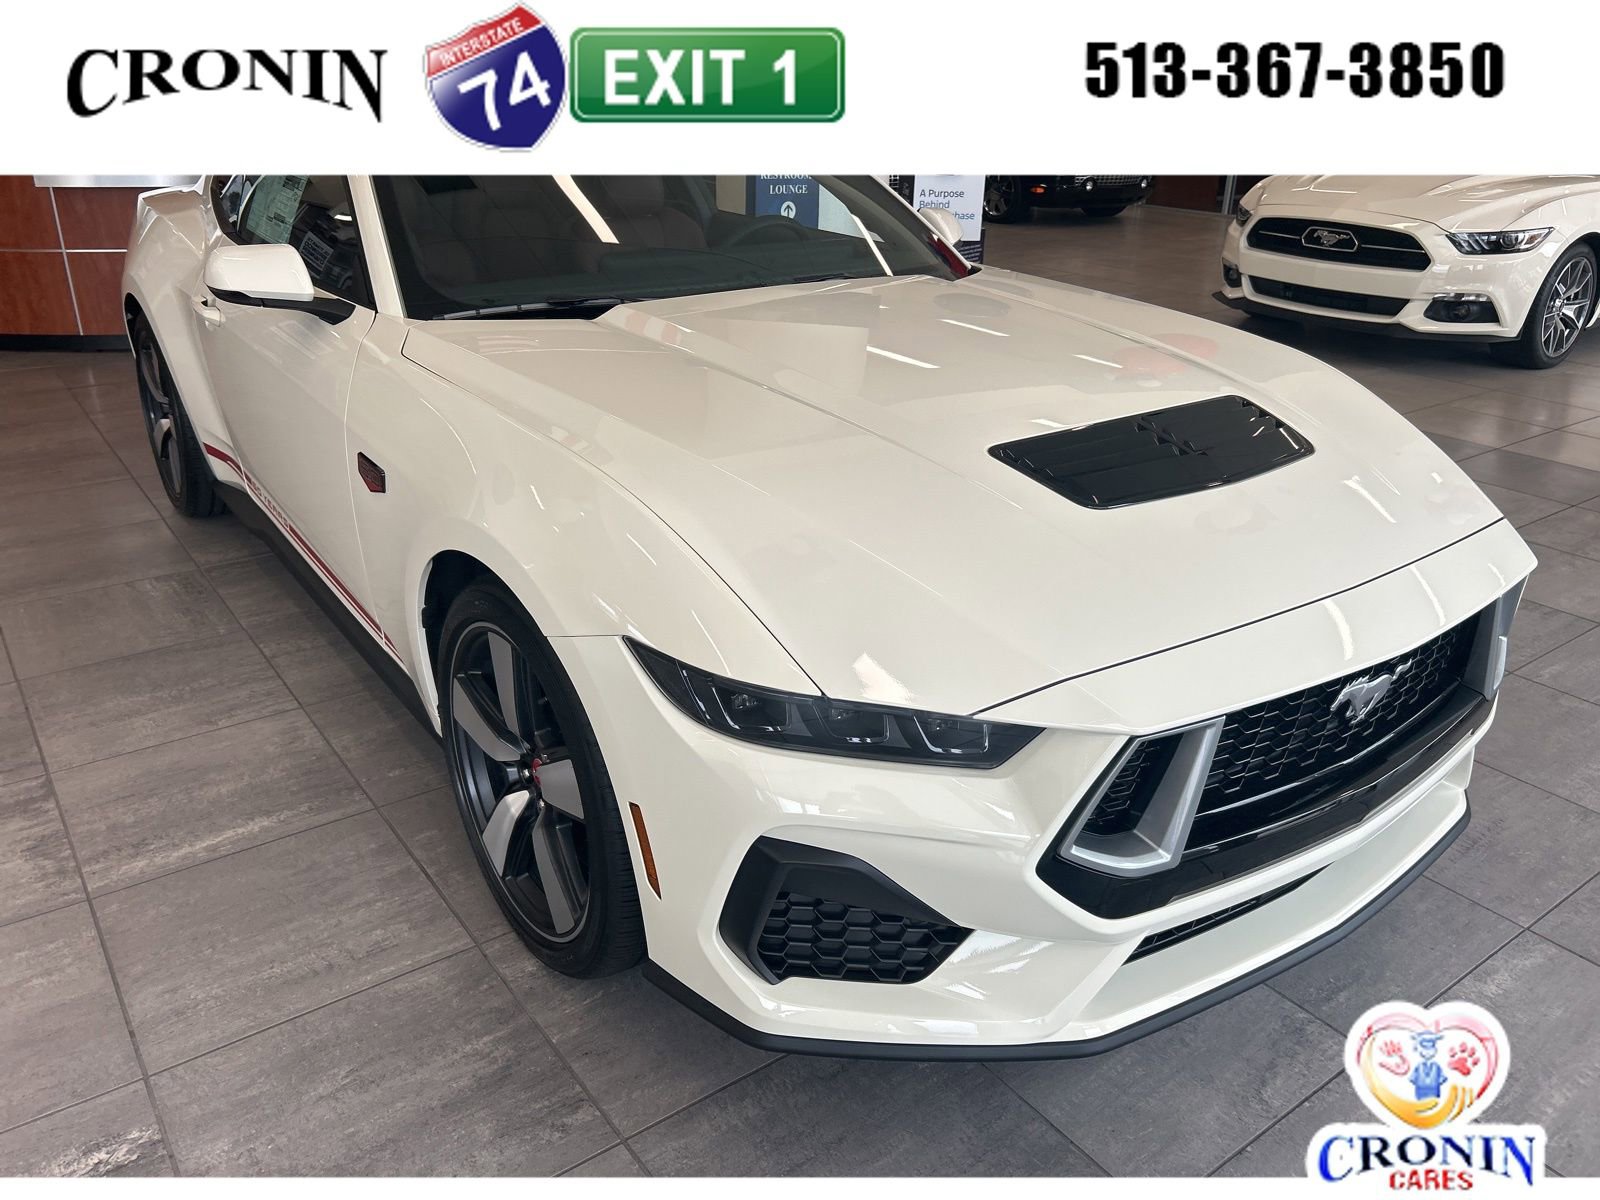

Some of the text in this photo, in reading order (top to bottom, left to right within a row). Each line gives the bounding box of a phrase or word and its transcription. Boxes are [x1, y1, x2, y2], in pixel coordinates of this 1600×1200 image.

[769, 184, 808, 195] LOUNGE
[919, 189, 965, 199] A Purpose
[919, 200, 950, 209] Behind
